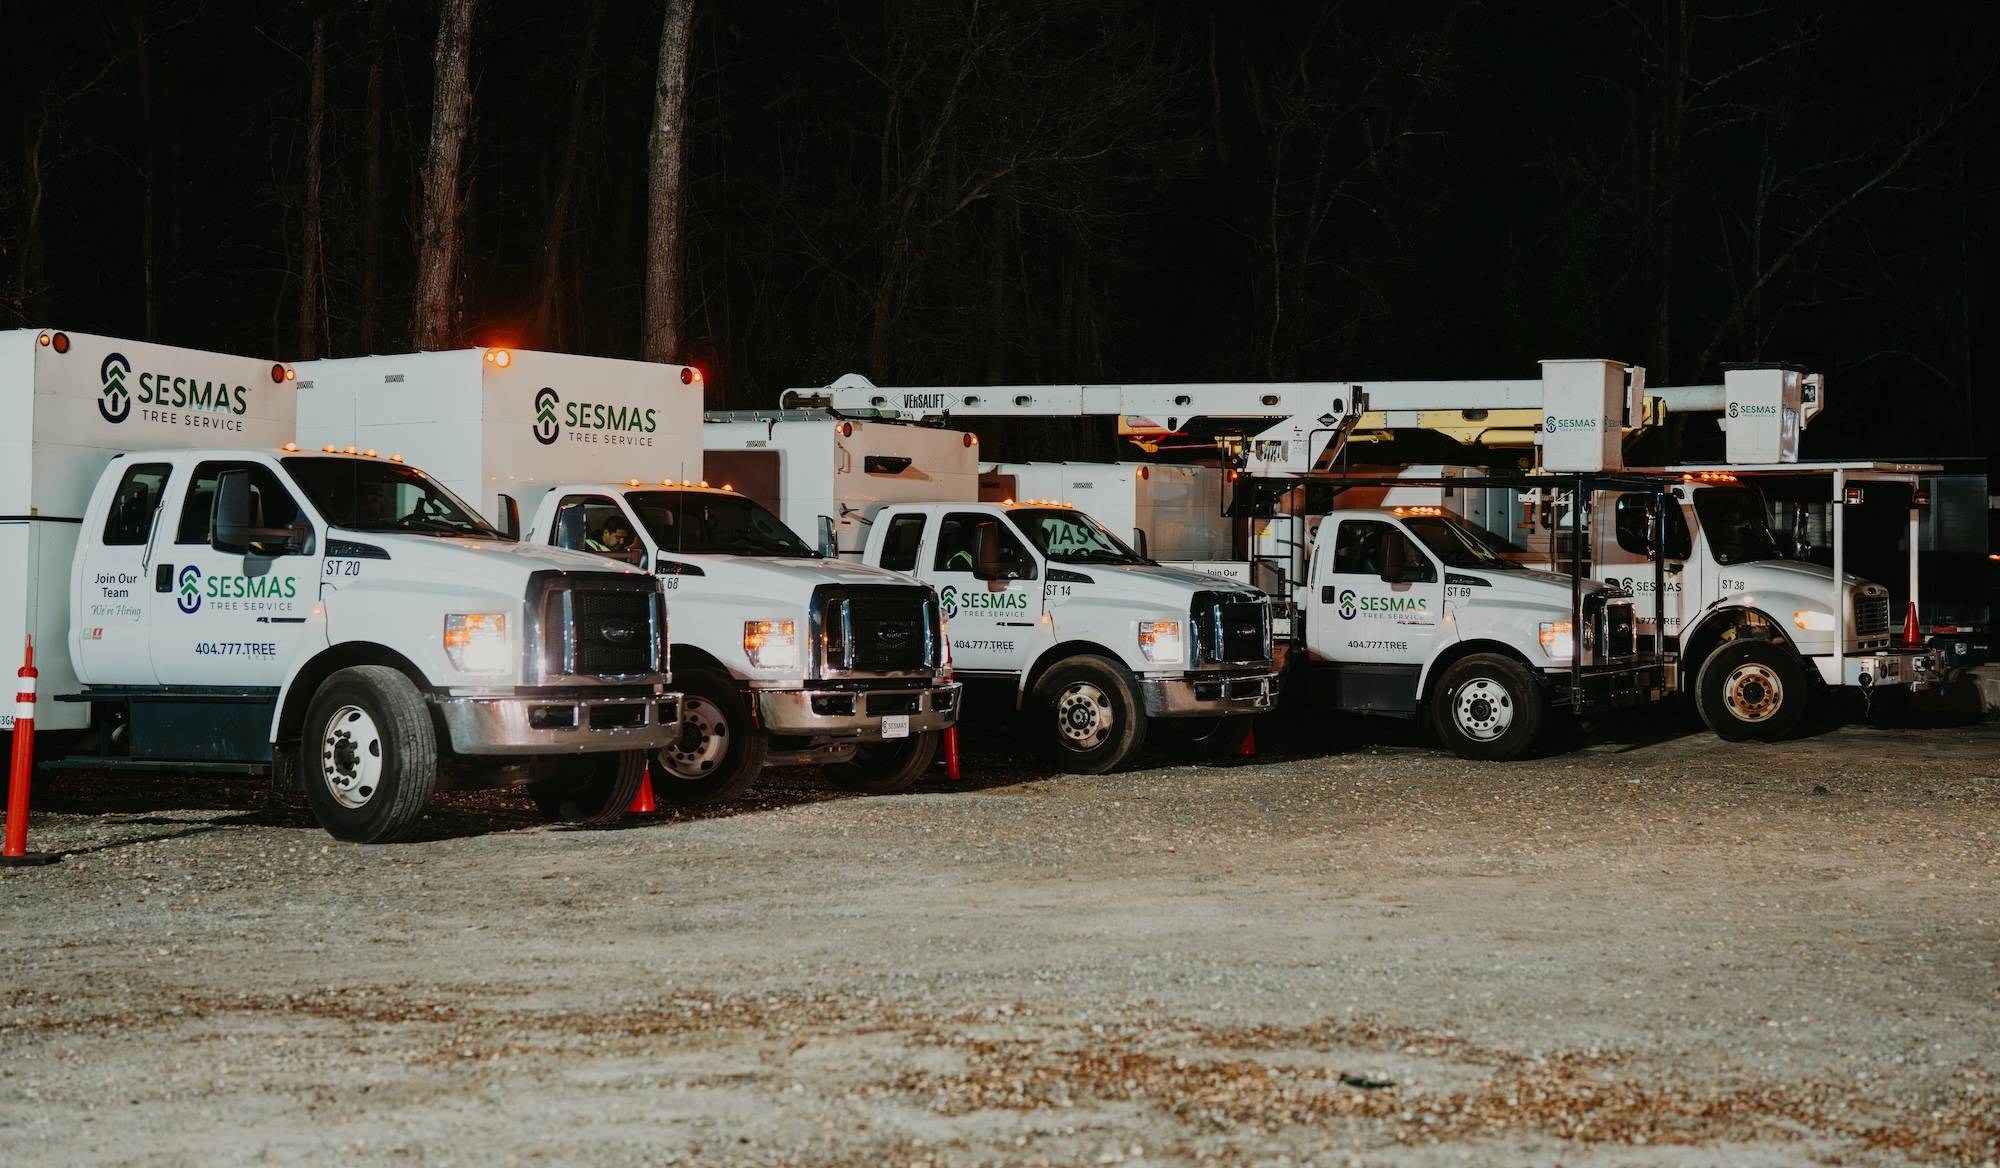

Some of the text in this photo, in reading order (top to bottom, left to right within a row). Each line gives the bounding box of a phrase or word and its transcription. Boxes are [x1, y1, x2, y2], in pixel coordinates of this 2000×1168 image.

[137, 372, 247, 415] SESMAS
[903, 393, 945, 409] VERSALIFT
[1740, 405, 1776, 414] SESMAS
[142, 409, 243, 432] TREE SERVICE
[565, 402, 656, 433] SESMAS
[1558, 419, 1596, 428] SESMAS
[569, 432, 653, 447] TREE SERVICE
[326, 560, 360, 576] ST 20
[1207, 569, 1238, 577] Join Our
[94, 572, 138, 584] Join Our
[667, 577, 679, 590] 68
[206, 575, 296, 598] SESMAS
[1046, 584, 1071, 597] ST 14
[1722, 579, 1745, 591] ST 38
[101, 587, 129, 598] Team
[1447, 586, 1471, 598] ST 69
[210, 602, 293, 611] TREE SERVICE
[961, 592, 1027, 609] SESMAS
[1360, 596, 1427, 612] SESMAS
[195, 642, 276, 656] 404.777.TREE
[954, 640, 1014, 650] 404.777.TREE
[1347, 640, 1408, 650] 404.777.TREE
